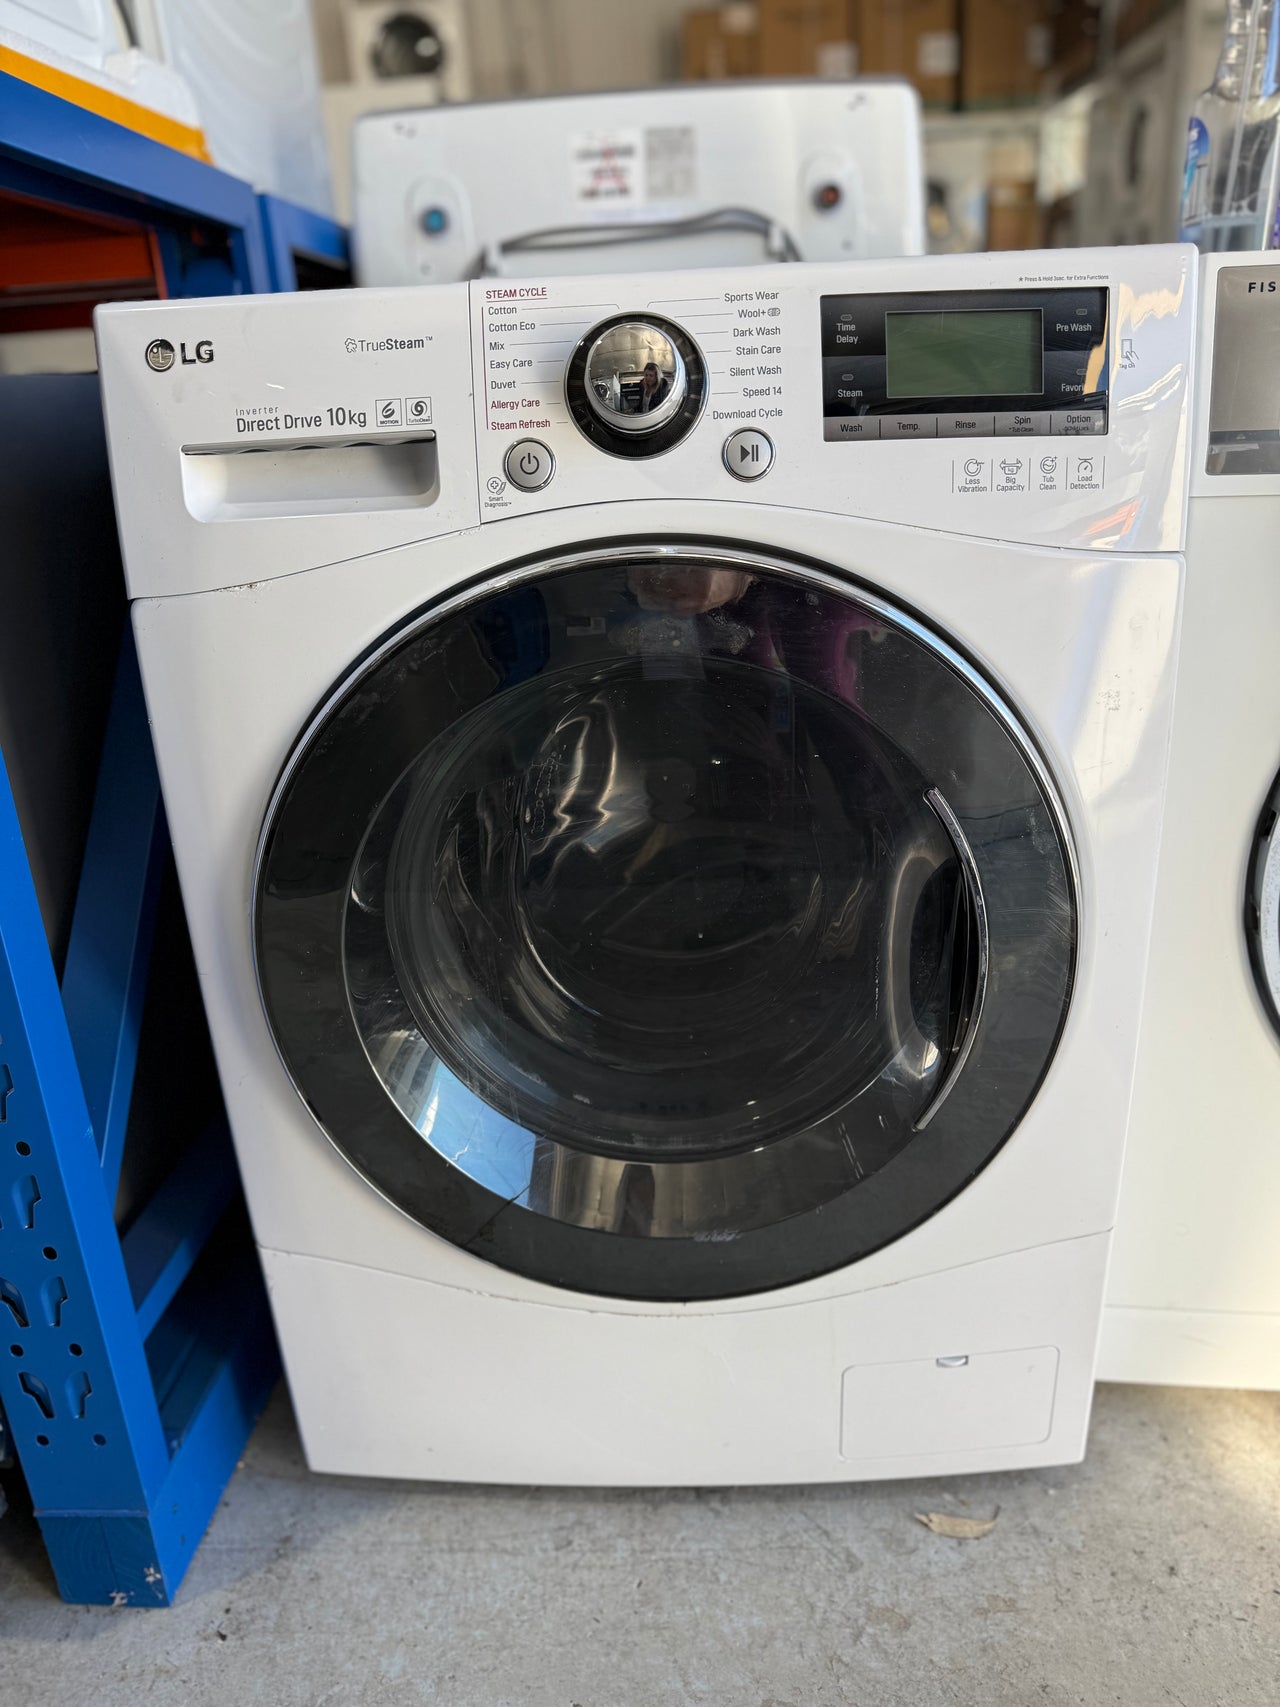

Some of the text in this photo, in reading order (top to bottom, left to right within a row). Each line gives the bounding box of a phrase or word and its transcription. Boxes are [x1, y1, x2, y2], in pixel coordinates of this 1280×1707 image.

[486, 287, 547, 299] STEAM CYCLE
[724, 291, 779, 303] Sports Wear
[488, 305, 517, 315] Cotton
[738, 308, 766, 318] Wool+
[489, 321, 535, 332] Cotton Eco
[837, 323, 856, 332] Time
[1056, 323, 1092, 332] Pre Wash
[733, 327, 780, 337] Dark Wash
[836, 335, 858, 344] Delay
[490, 342, 504, 350] Mix
[736, 345, 781, 355] Stain Care
[181, 341, 214, 365] LG
[490, 359, 532, 369] Easy Care
[730, 366, 782, 376] Silent Wash
[491, 380, 516, 389] Duvet
[1062, 384, 1084, 392] Favori
[743, 387, 782, 398] Speed 14
[838, 389, 863, 397] Steam
[491, 398, 540, 410] Allergy Care
[236, 406, 278, 416] Inverter
[713, 407, 783, 419] Download Cycle
[237, 418, 280, 432] Direct
[285, 413, 322, 428] Drive
[1014, 416, 1031, 426] Spin
[1066, 414, 1091, 424] Option
[491, 419, 550, 430] Steam Refresh
[840, 423, 862, 432] Wash
[897, 422, 920, 432] Temp.
[955, 420, 976, 429] Rinse
